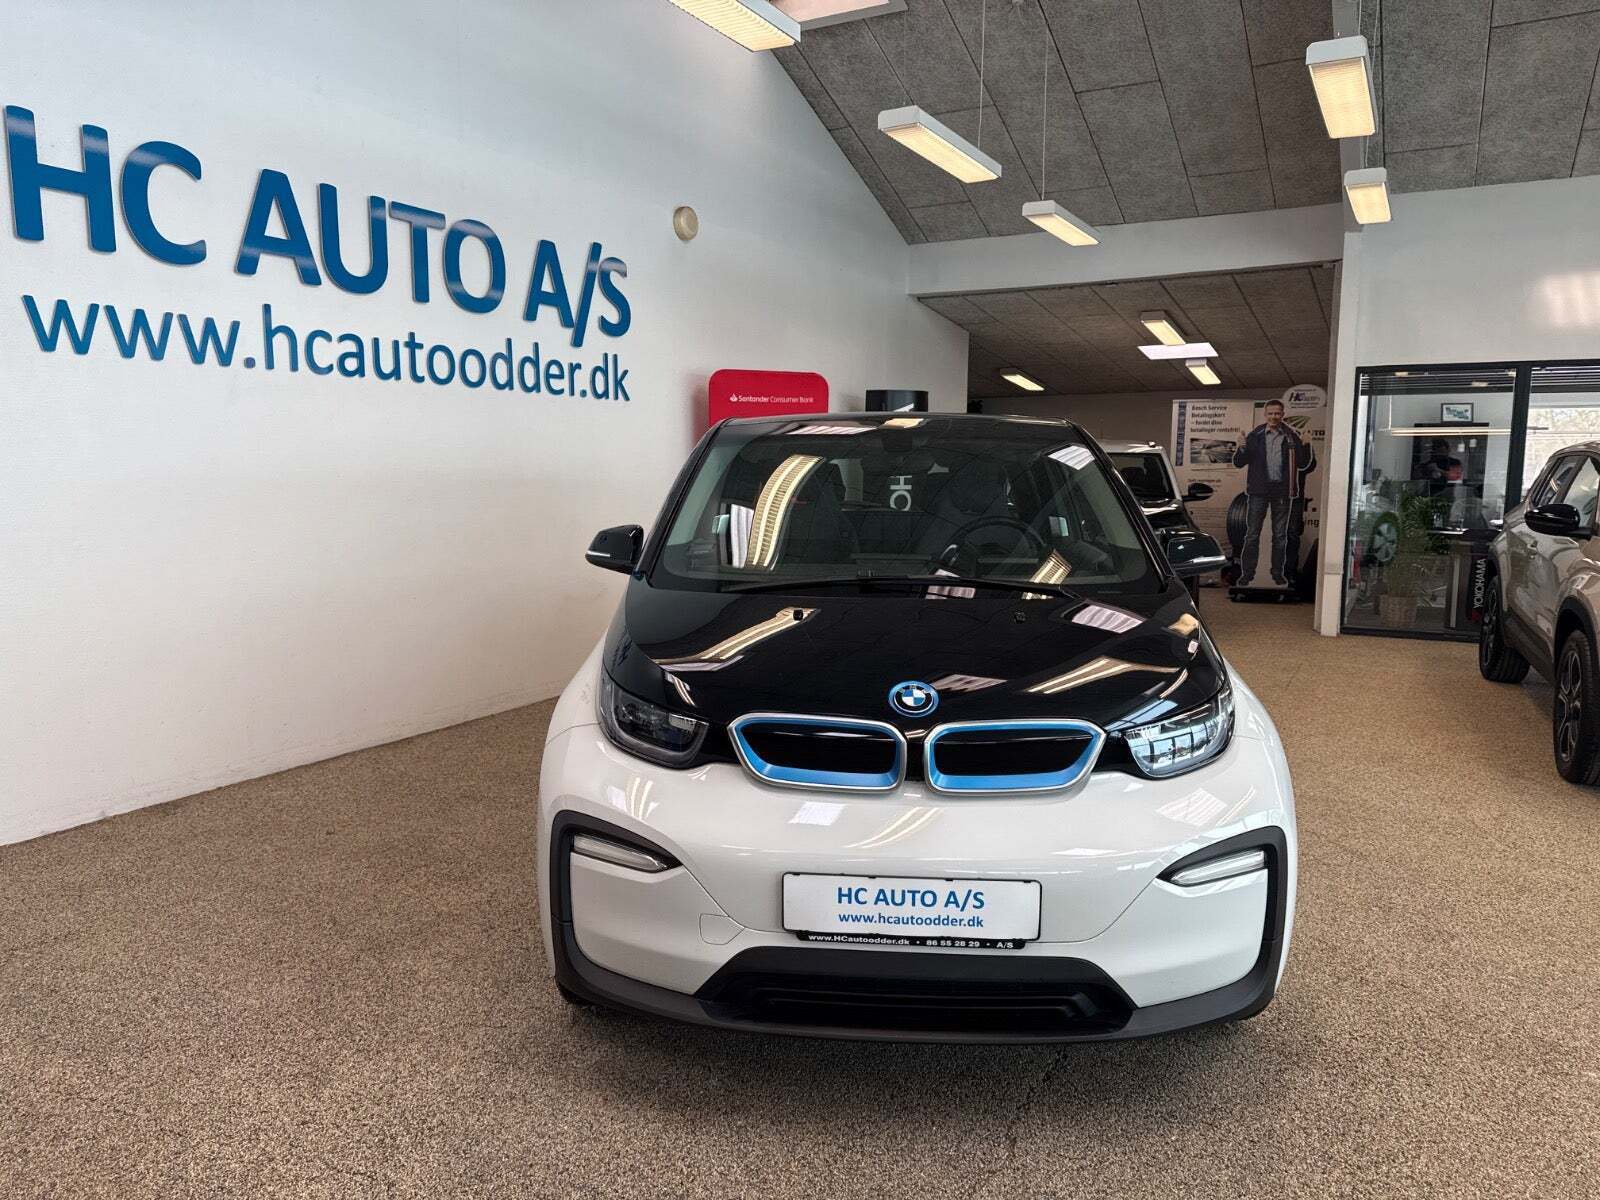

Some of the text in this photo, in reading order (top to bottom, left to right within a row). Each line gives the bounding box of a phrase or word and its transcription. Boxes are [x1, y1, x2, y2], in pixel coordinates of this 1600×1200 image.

[4, 104, 632, 348] HC AUTO A/S
[21, 294, 631, 402] www.hcautoodder.dk
[738, 395, 769, 403] Santander
[1473, 558, 1486, 609] YOKOHAMA
[837, 886, 985, 912] HC AUTO A/S
[838, 912, 984, 928] www.hcautoodder.dk
[808, 934, 910, 945] www.HCautoodder.dk
[996, 941, 1014, 949] A/S
